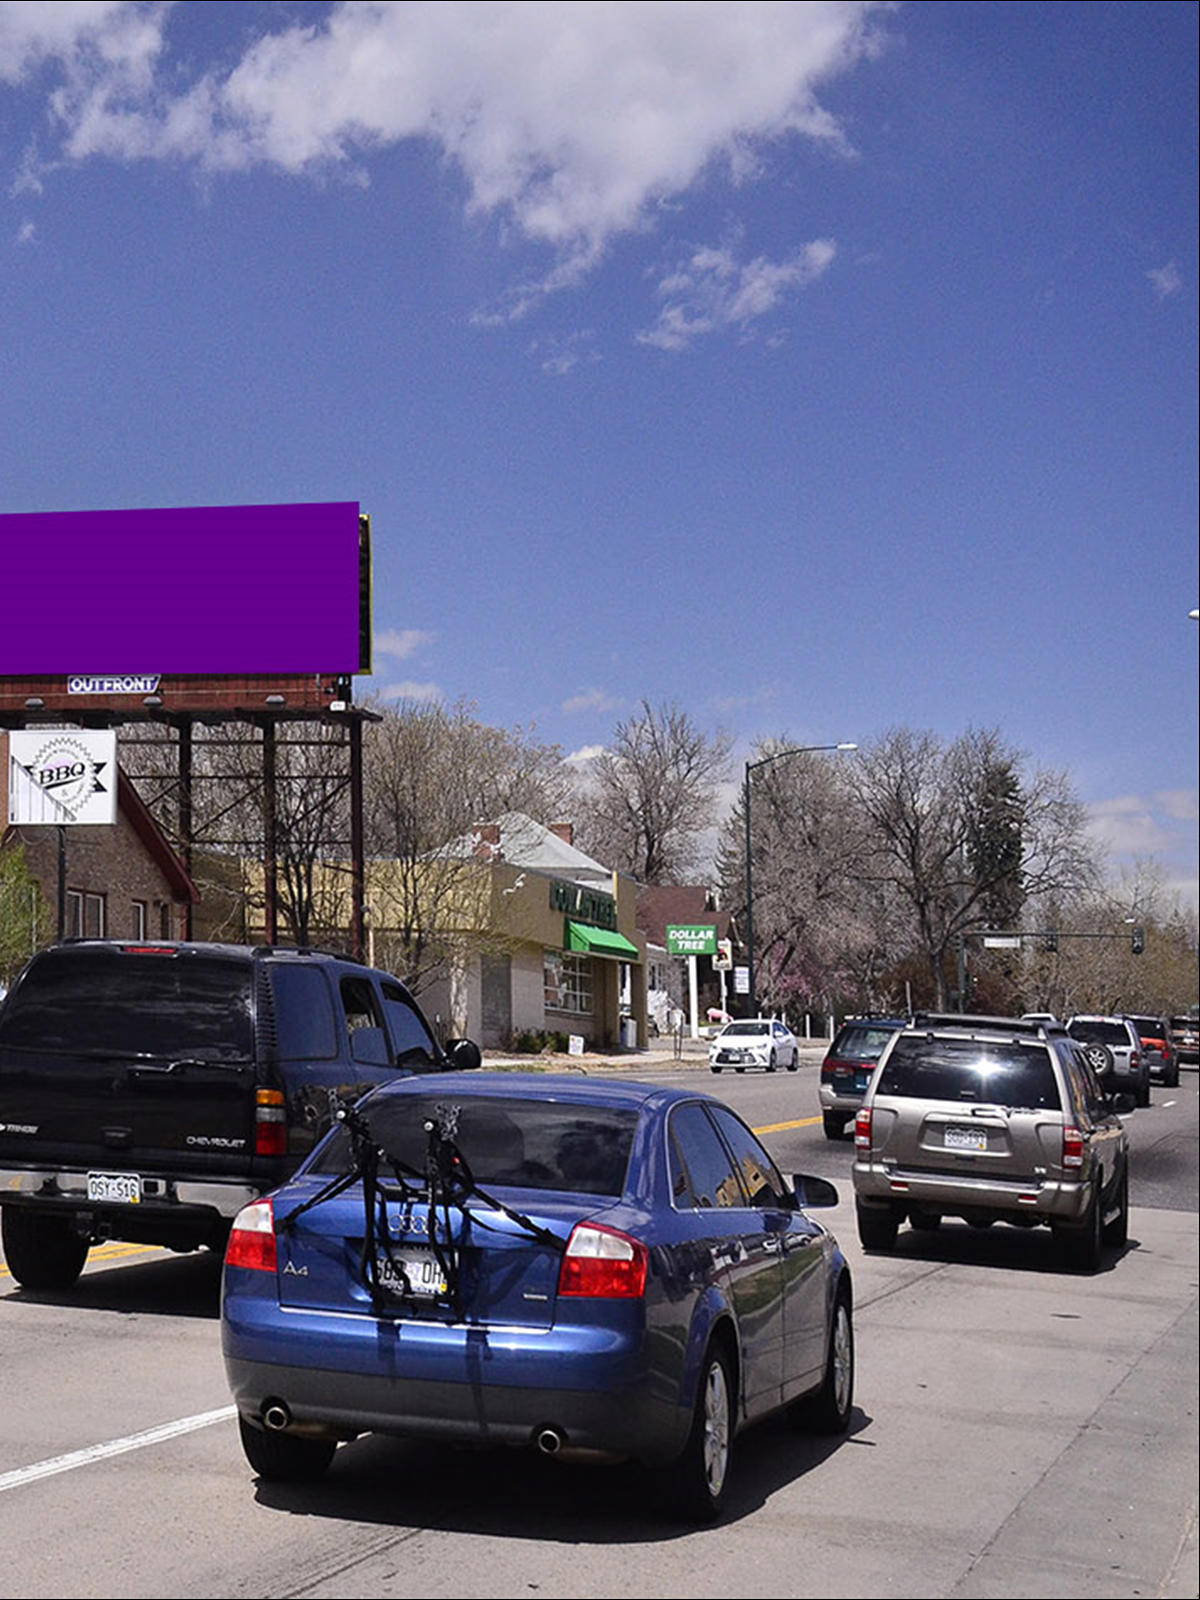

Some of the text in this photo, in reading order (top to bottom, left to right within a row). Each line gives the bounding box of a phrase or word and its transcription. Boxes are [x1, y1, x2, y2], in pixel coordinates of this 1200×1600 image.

[70, 677, 155, 691] OUTFRONT
[39, 761, 86, 785] BBQ
[669, 930, 714, 939] DOLLAR
[677, 940, 705, 950] TREE
[283, 1261, 308, 1276] A4
